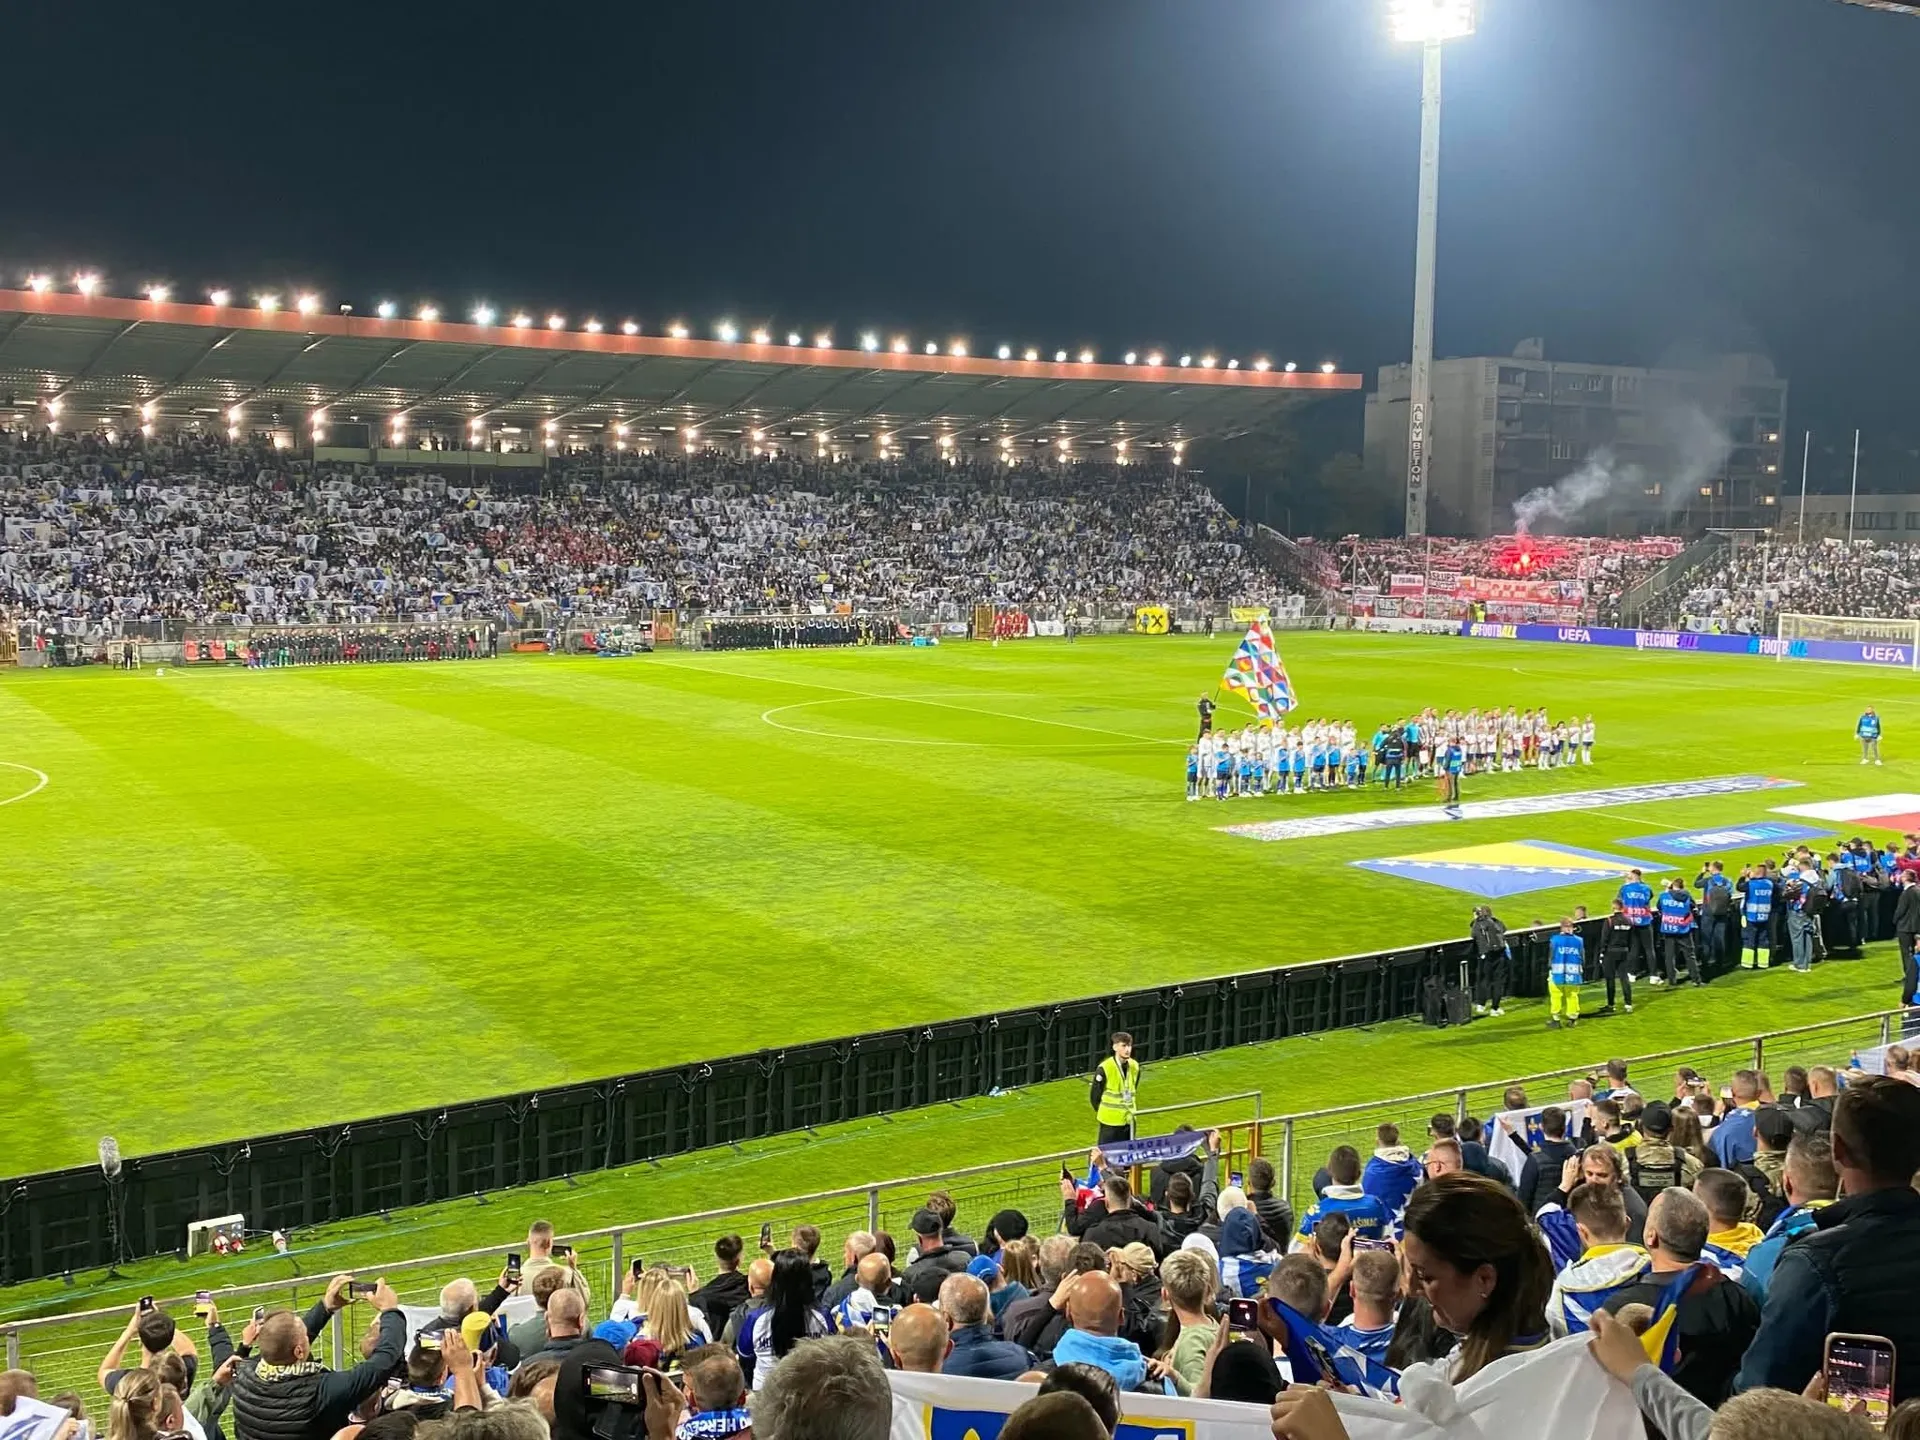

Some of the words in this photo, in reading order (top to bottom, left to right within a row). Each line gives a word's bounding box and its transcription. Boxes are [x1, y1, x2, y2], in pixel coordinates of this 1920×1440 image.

[1411, 443, 1422, 482] BETON
[1558, 628, 1591, 642] UEFA
[1862, 646, 1905, 662] UEFA
[1662, 899, 1684, 908] UEFA
